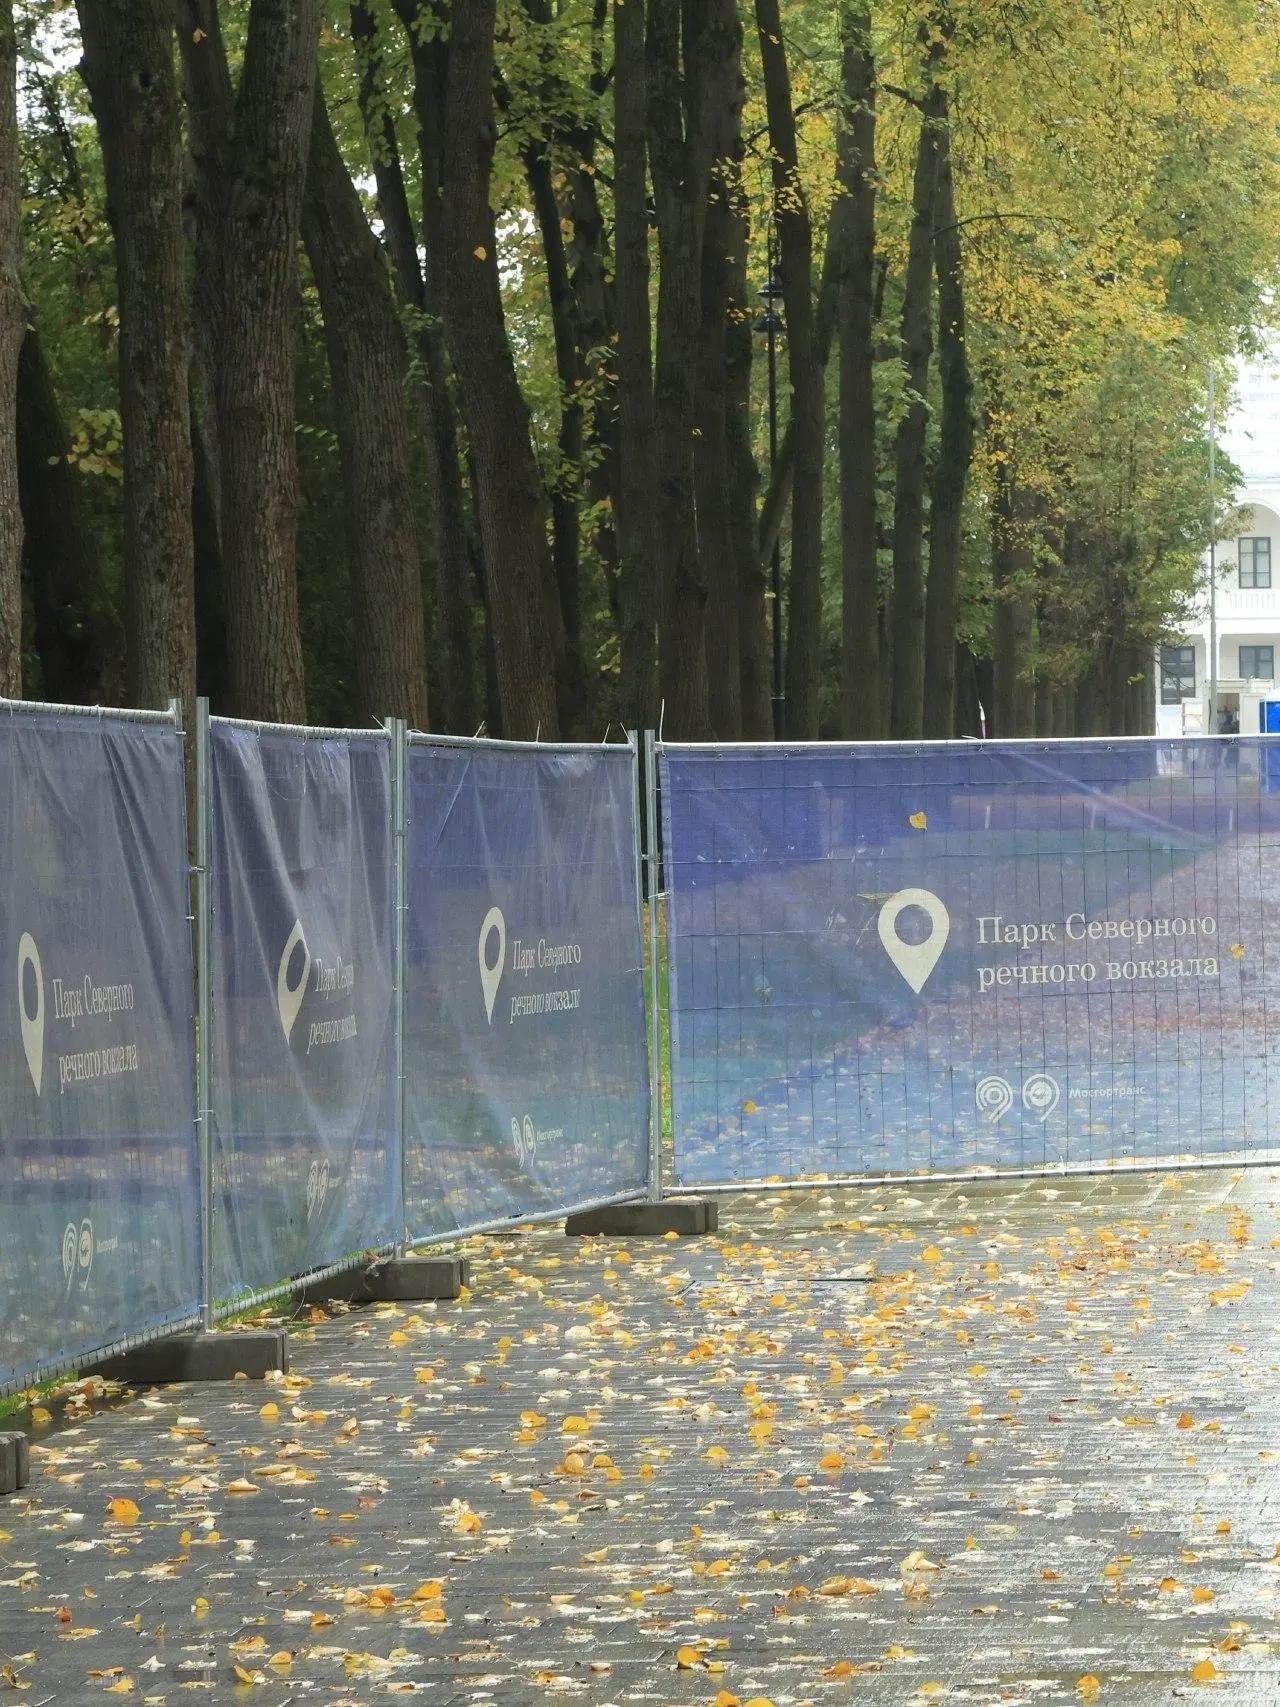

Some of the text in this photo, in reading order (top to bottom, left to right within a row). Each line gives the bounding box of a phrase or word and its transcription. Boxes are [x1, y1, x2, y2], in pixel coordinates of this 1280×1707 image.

[975, 912, 1218, 949] Парк Северного
[513, 940, 536, 977] Парк
[976, 955, 1220, 992] речного вокзала
[52, 974, 135, 1028] Парк Северного
[509, 992, 545, 1025] речного
[58, 1050, 101, 1095] речного
[1067, 1085, 1147, 1101] Мосгортранс
